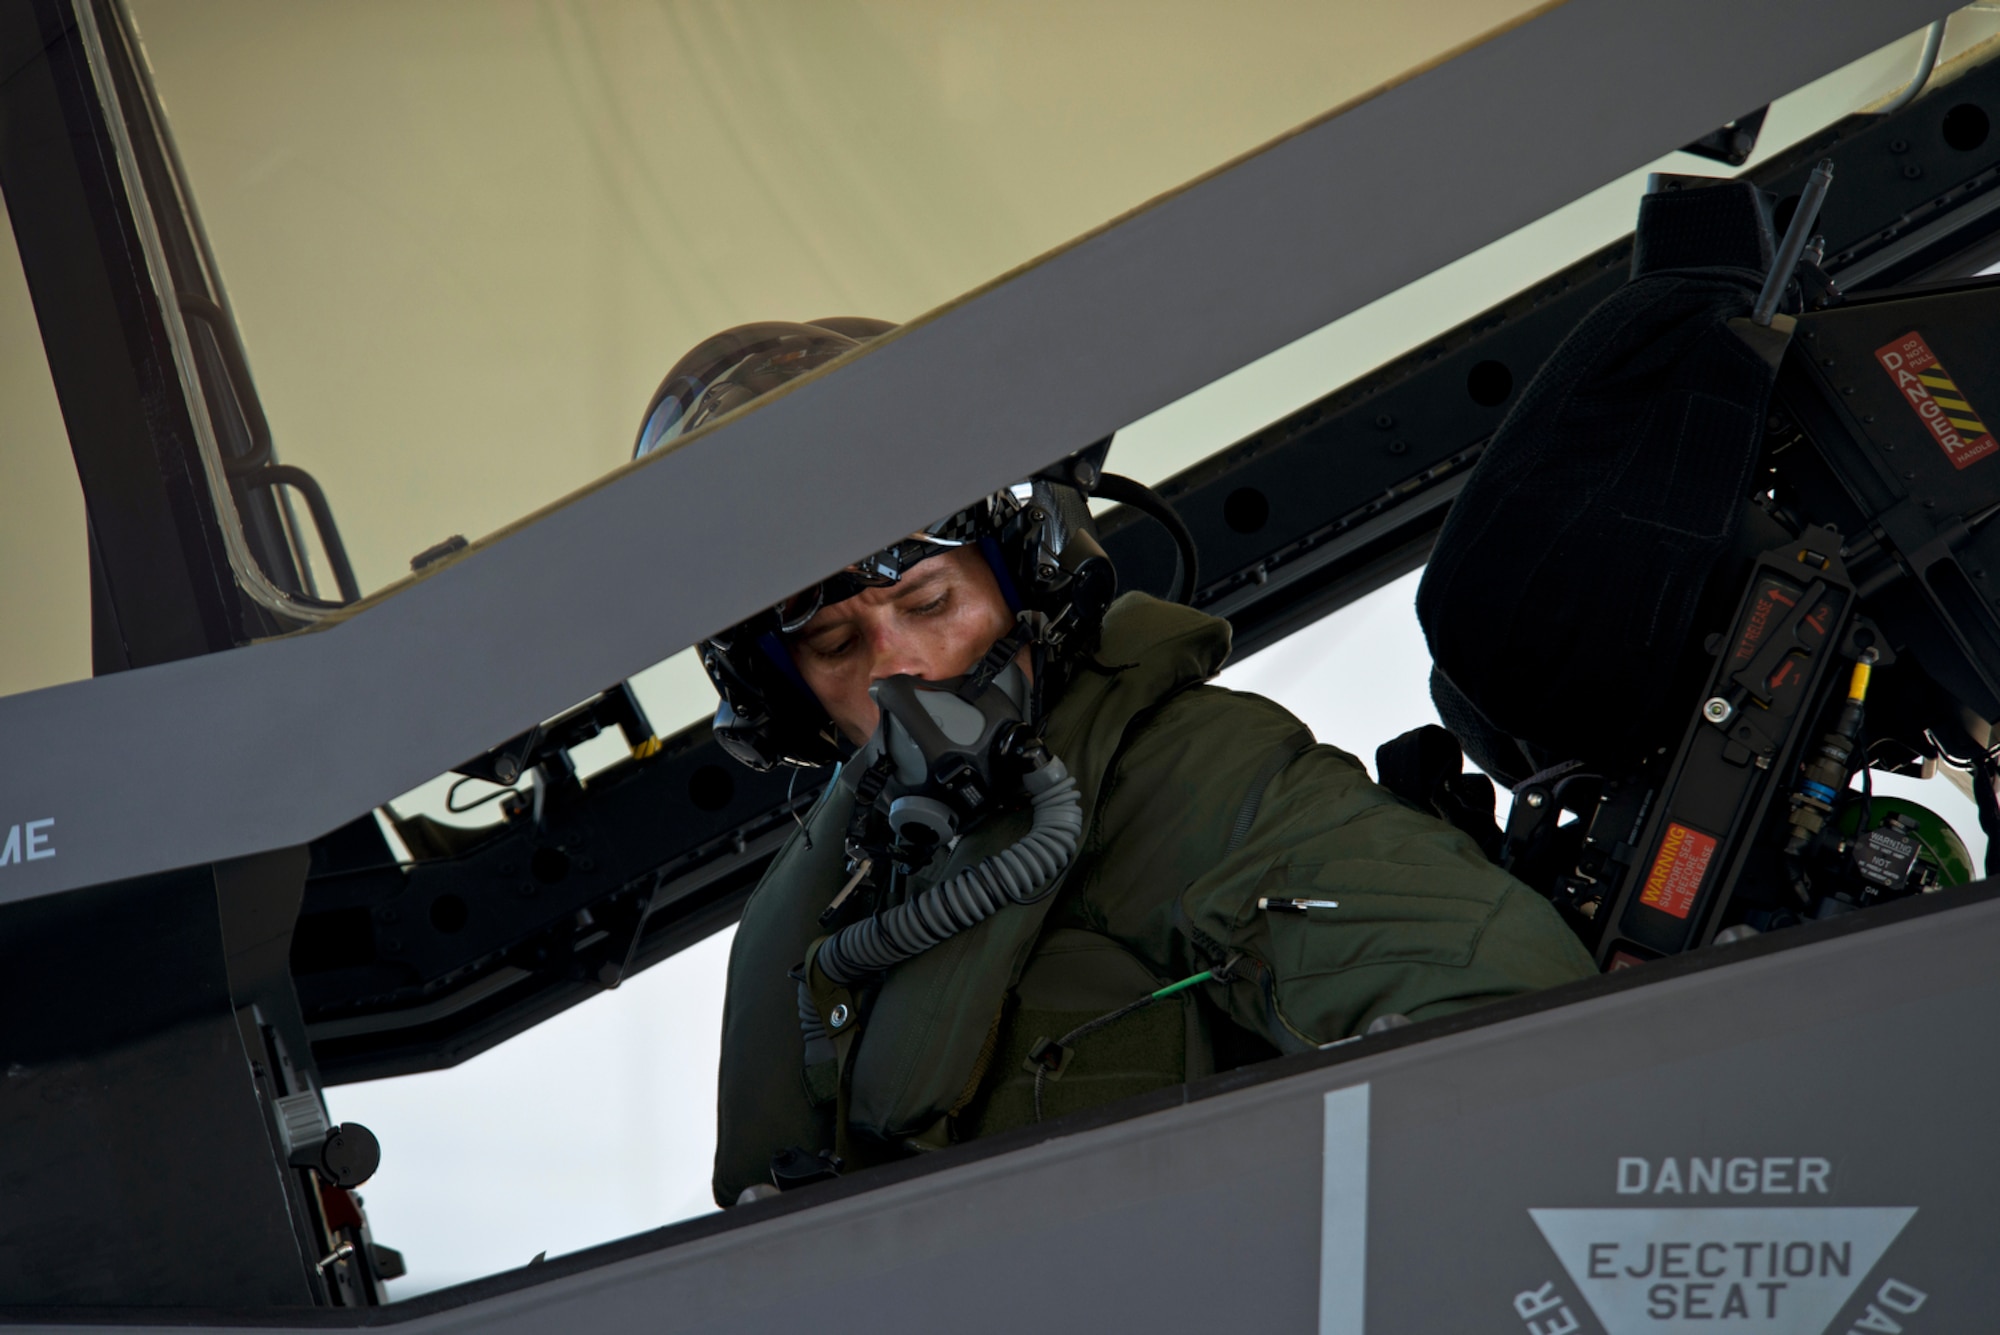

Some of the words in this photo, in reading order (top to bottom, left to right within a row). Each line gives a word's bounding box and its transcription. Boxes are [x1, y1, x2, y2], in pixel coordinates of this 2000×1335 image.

[1902, 340, 1917, 351] DO
[1906, 346, 1925, 360] NOT
[1909, 354, 1933, 369] PULL
[1882, 351, 1965, 454] DANGER
[1957, 439, 1993, 463] HANDLE
[1736, 637, 1756, 660] TILT
[1747, 598, 1774, 642] RELEASE
[1817, 607, 1828, 621] 2
[1792, 672, 1801, 686] 1
[1871, 832, 1912, 854] WARNING
[1642, 827, 1686, 902] WARNING
[1658, 860, 1685, 907] SUPPORT
[1679, 833, 1696, 860] SEAT
[1675, 855, 1698, 895] BEFORE
[1679, 891, 1695, 910] TILT
[1689, 845, 1714, 889] RELEASE
[1871, 856, 1891, 868] NOT
[1864, 886, 1879, 896] ON
[1616, 1157, 1831, 1194] DANGER
[1587, 1241, 1852, 1279] EJECTION
[1647, 1282, 1788, 1320] SEAT
[1845, 1277, 1928, 1335] DA
